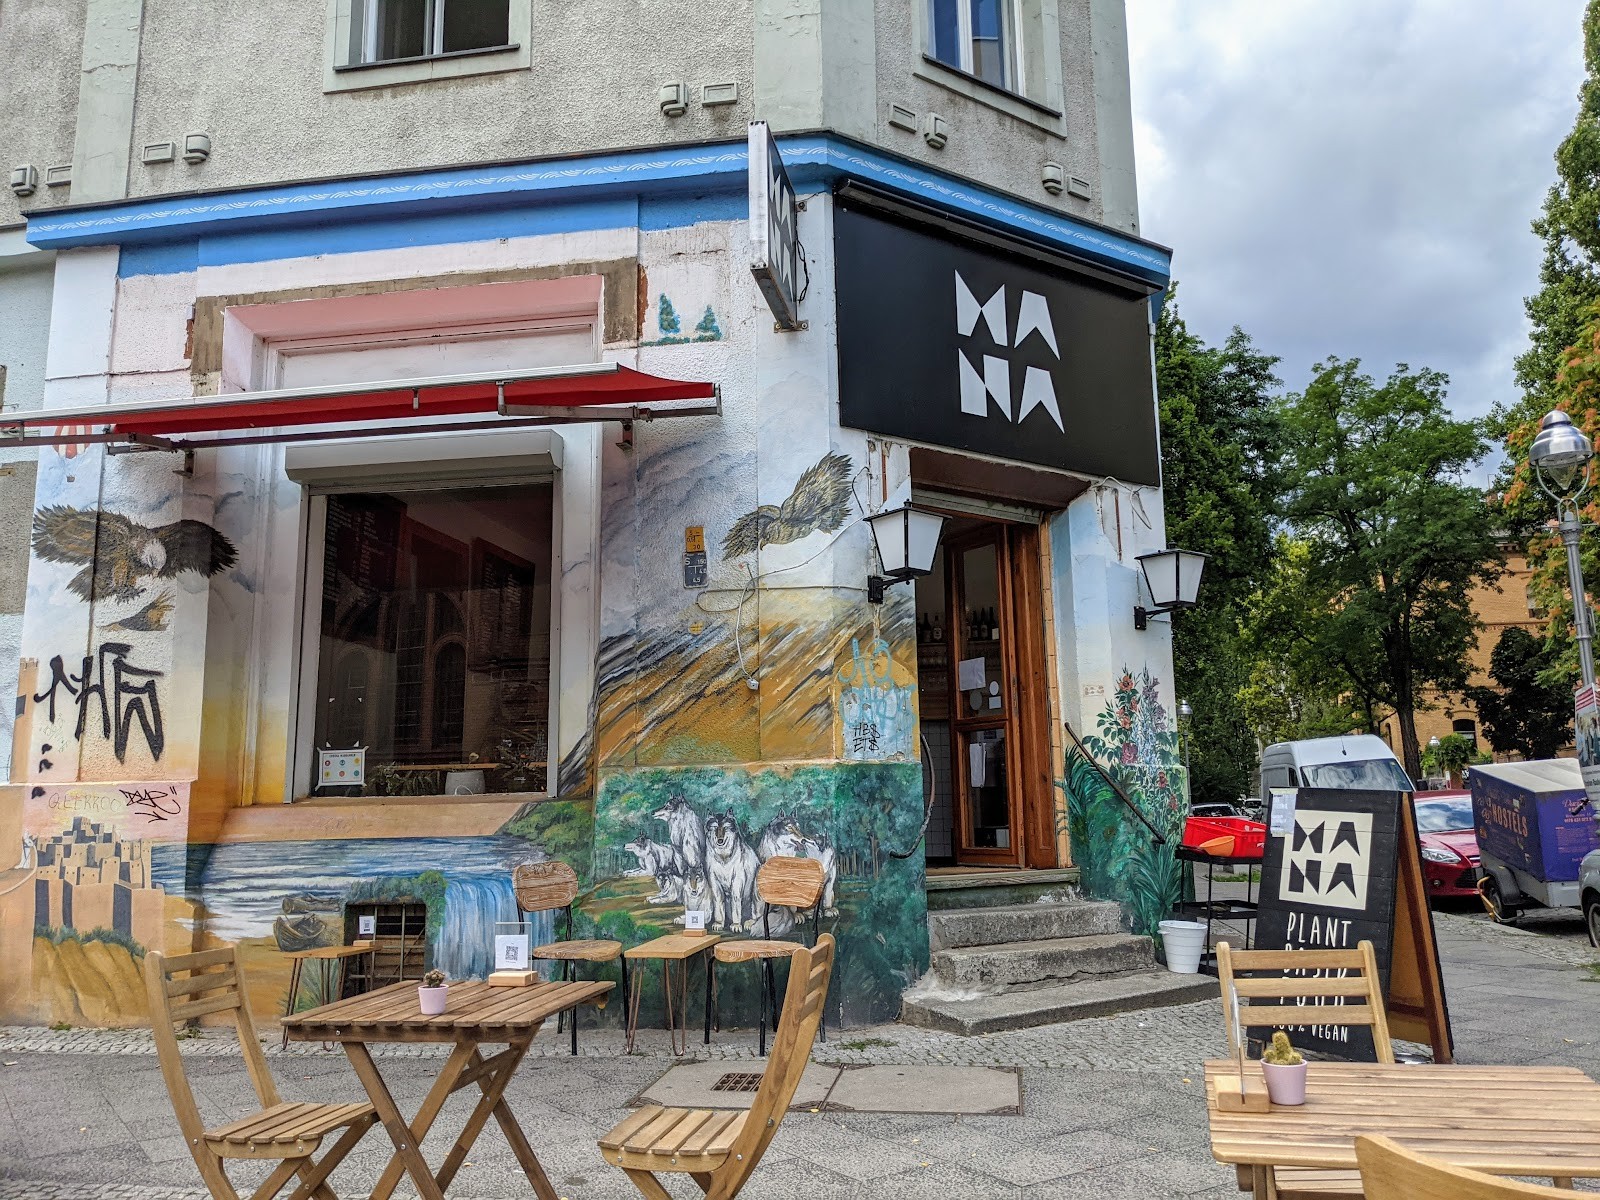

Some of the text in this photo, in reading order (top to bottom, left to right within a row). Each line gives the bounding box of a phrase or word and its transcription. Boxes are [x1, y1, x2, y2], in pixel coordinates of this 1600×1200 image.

[954, 269, 1061, 361] MA
[957, 347, 1065, 434] NA
[1491, 803, 1529, 838] HOSTELS
[1286, 911, 1353, 948] PLANT
[1311, 1023, 1348, 1043] VEGAN
